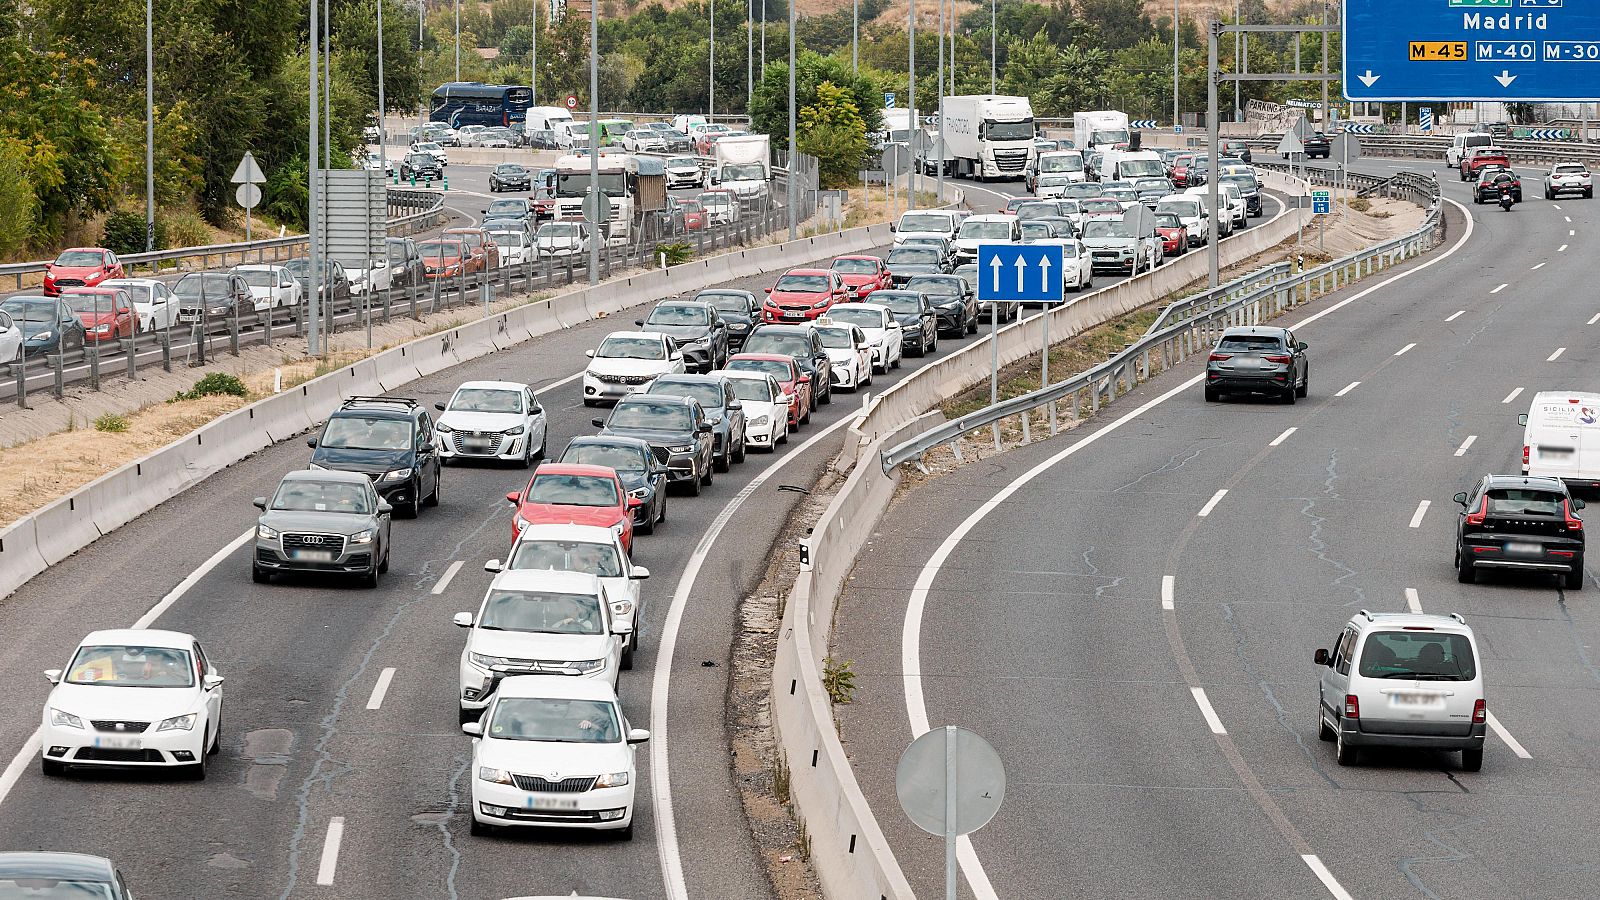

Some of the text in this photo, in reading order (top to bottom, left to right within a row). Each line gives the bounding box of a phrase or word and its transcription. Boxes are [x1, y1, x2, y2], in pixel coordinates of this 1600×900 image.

[1463, 13, 1547, 30] Madrid
[1412, 44, 1599, 59] M-45 M-40 M-30
[475, 105, 496, 113] BARAZA
[1249, 99, 1278, 113] PARKING
